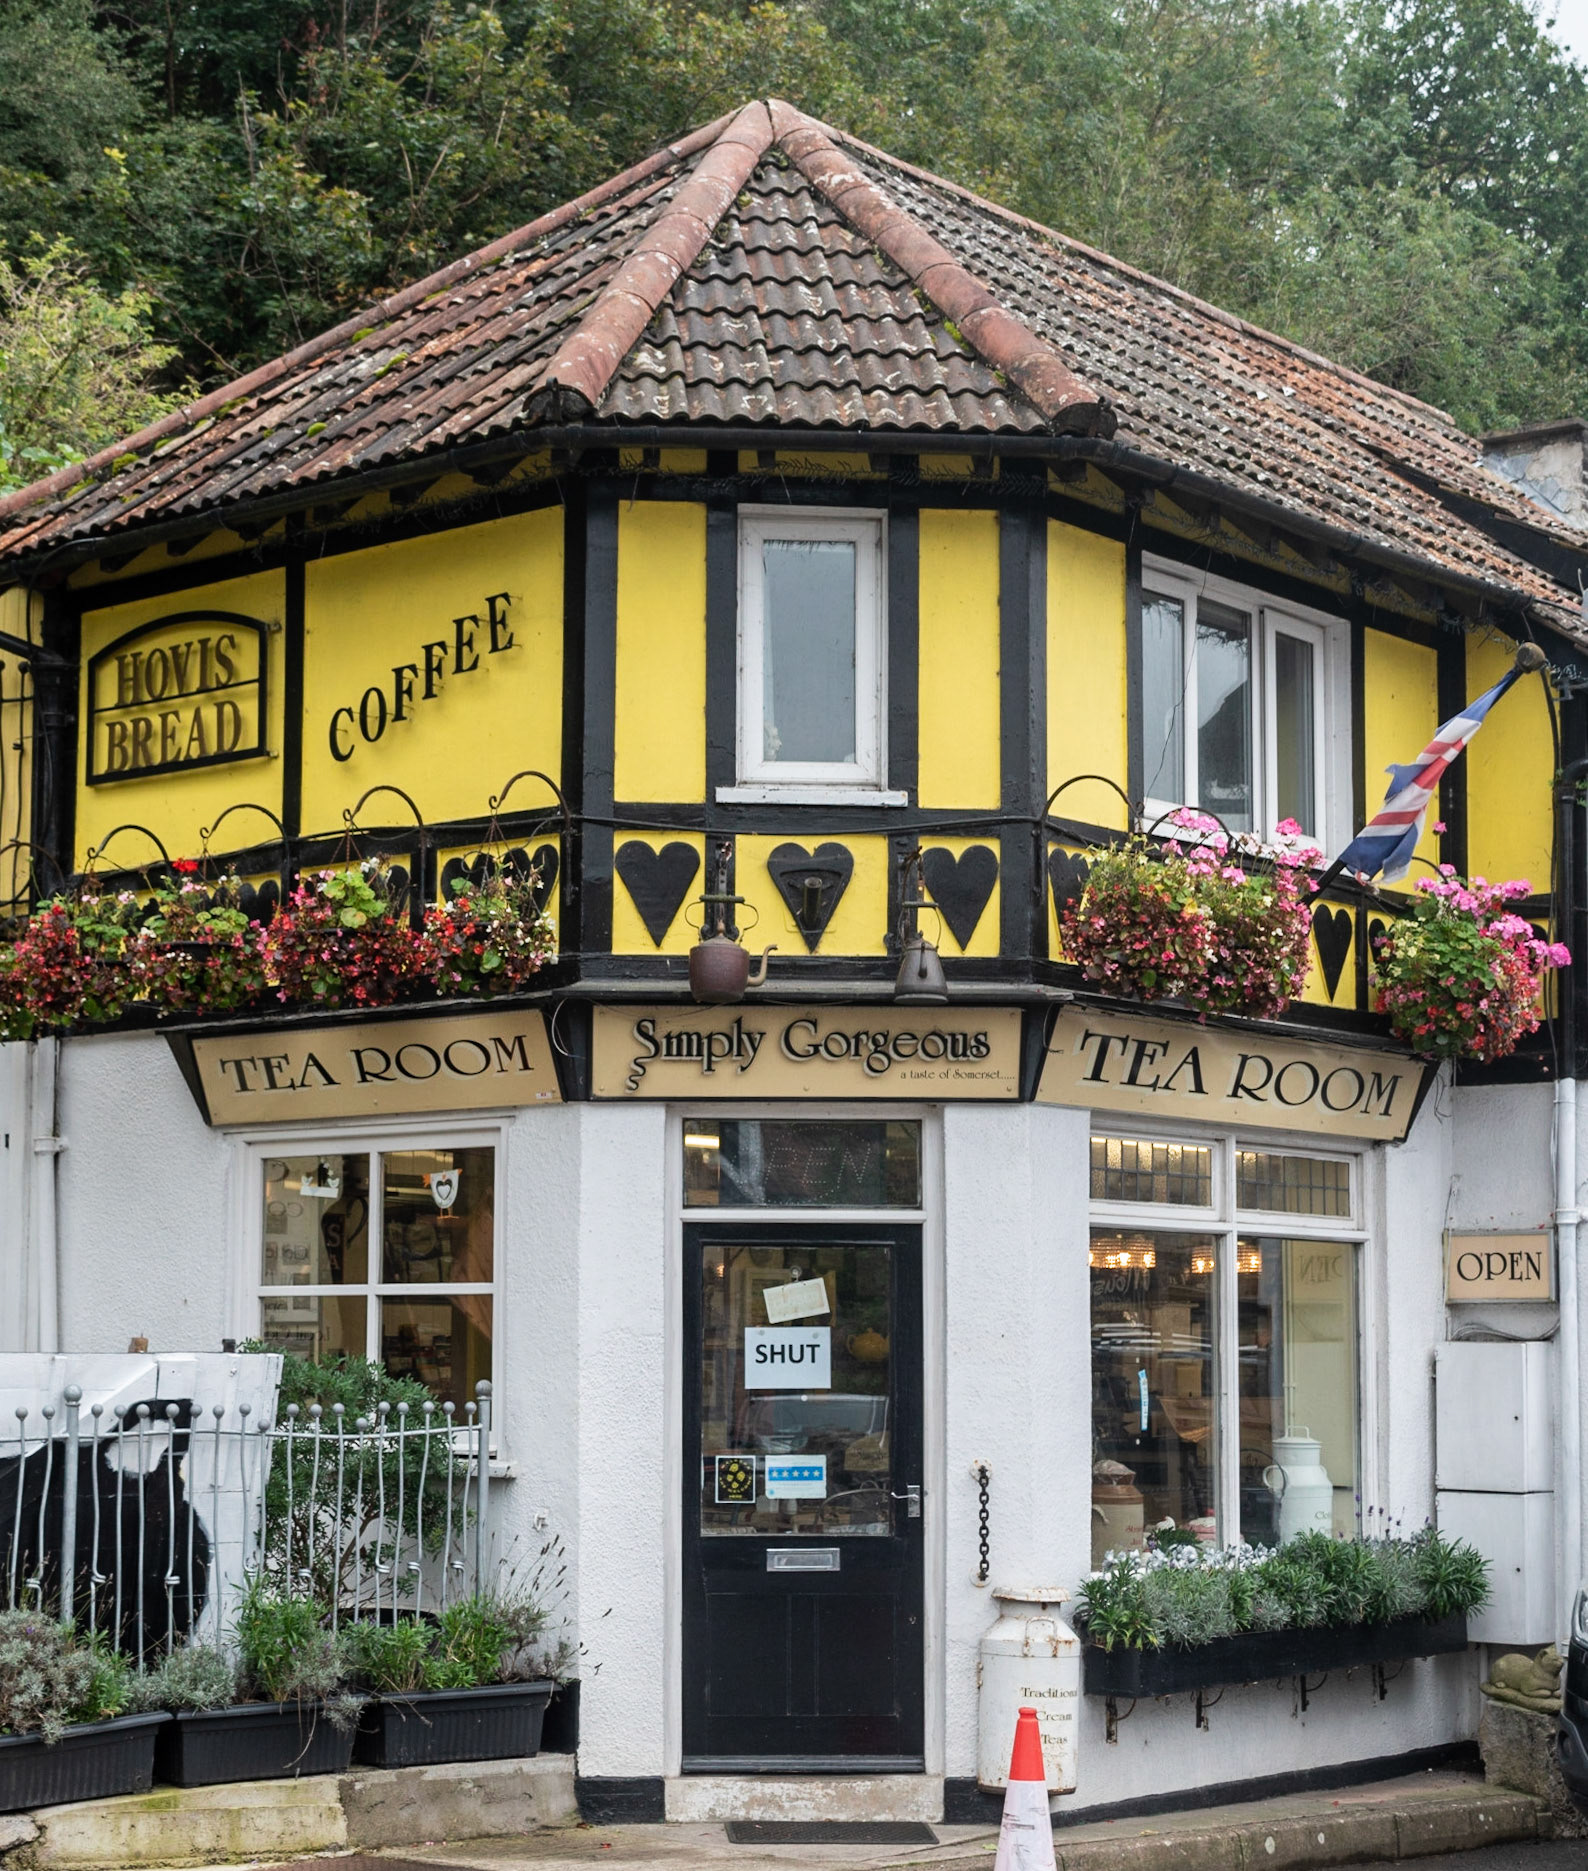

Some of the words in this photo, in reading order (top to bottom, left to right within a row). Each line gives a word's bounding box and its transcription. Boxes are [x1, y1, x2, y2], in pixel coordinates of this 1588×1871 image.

[115, 634, 237, 707] HOVIS
[328, 592, 515, 762] COFFEE
[105, 700, 242, 773] BREAD
[220, 1052, 341, 1093] TEA
[350, 1035, 535, 1084] ROOM
[626, 1016, 766, 1092] Simply
[781, 1018, 991, 1076] Gorgeous
[910, 1069, 935, 1079] taste
[939, 1068, 950, 1079] of
[1081, 1028, 1209, 1095] TEA
[1226, 1053, 1403, 1117] ROOM
[1456, 1251, 1543, 1283] OPEN
[755, 1344, 820, 1364] SHUT
[1036, 1710, 1073, 1722] Cream
[1041, 1733, 1068, 1745] Teas
